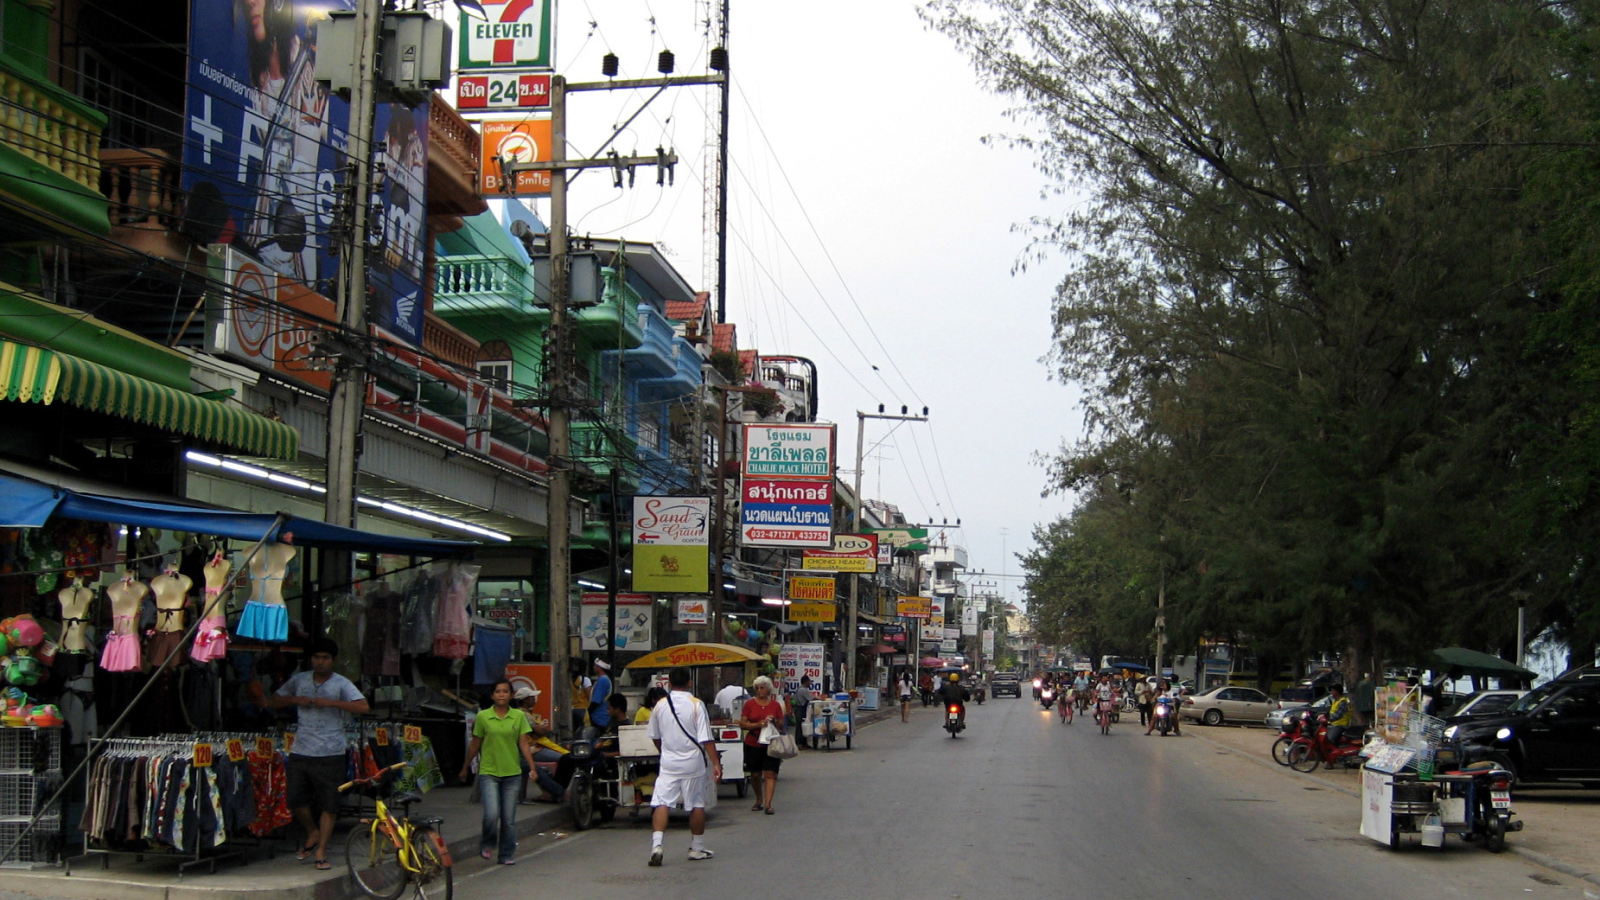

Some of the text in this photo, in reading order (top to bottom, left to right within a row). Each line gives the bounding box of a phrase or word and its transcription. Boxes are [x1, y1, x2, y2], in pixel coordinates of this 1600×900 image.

[460, 81, 485, 98] เปิด
[489, 80, 517, 103] 24
[518, 173, 550, 187] Smile
[278, 307, 325, 352] Boo
[395, 316, 416, 336] HONDA
[766, 428, 812, 441] โรงแรม
[748, 463, 827, 474] CHARLIE PLACE HOTEL
[637, 499, 691, 529] Sand
[745, 506, 830, 524] นวดแผนโบราณ
[662, 524, 704, 540] Grain
[803, 668, 820, 677] 250
[196, 746, 211, 764] 120
